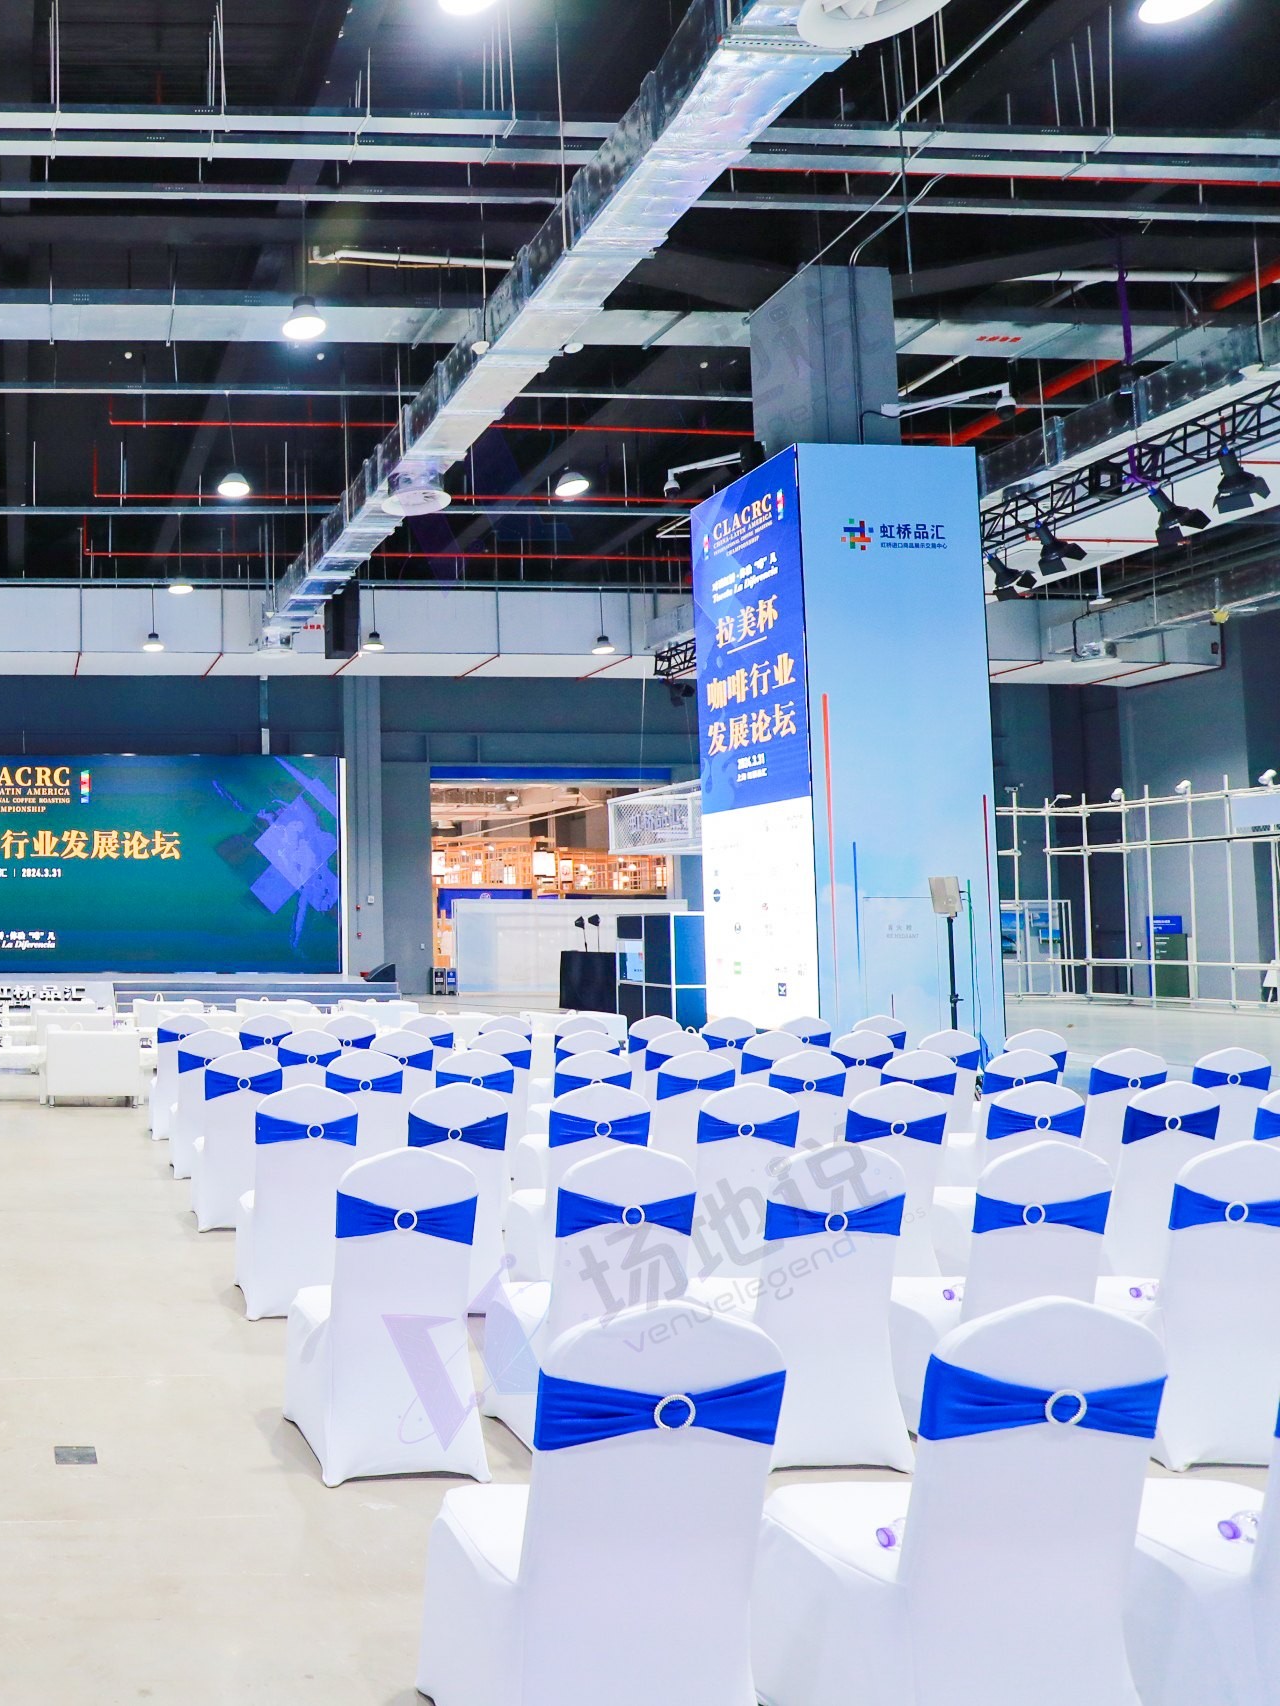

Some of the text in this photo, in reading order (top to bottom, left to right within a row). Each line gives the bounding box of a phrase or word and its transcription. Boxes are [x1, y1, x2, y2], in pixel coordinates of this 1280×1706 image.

[712, 493, 772, 541] CLACRC
[748, 512, 772, 530] AMERICA
[880, 523, 946, 539] 虹桥品汇
[715, 594, 778, 648] 拉美杯
[706, 652, 797, 712] 咖啡行业
[707, 700, 797, 756] 发展论坛
[26, 788, 70, 796] AMERICA
[21, 868, 62, 878] 2024.3.31
[1, 940, 13, 949] La
[14, 940, 56, 950] Diferencia
